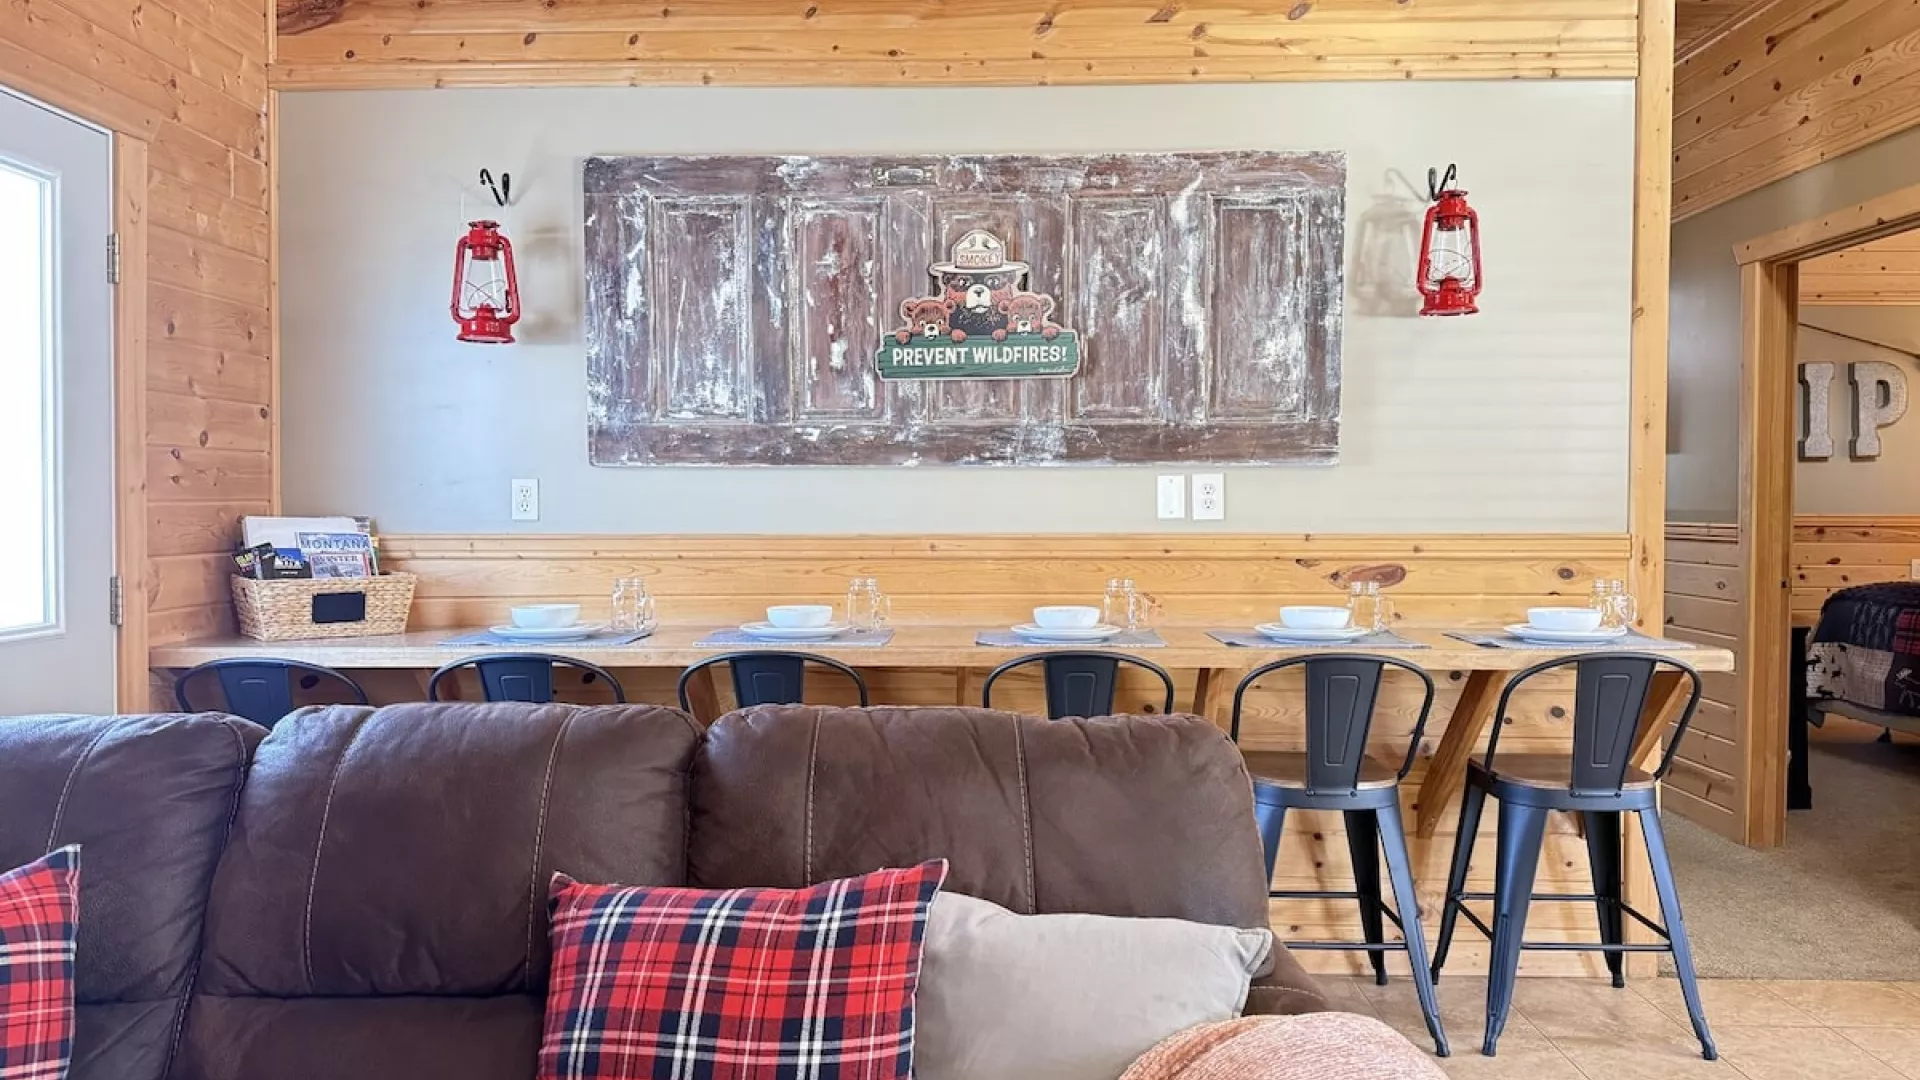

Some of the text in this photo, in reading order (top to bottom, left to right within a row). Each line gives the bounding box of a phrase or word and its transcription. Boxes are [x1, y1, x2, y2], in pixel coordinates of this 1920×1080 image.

[959, 253, 999, 265] SMOKEY
[892, 345, 1068, 366] PREVENT WILDFIRES!
[300, 539, 370, 549] MONTANA
